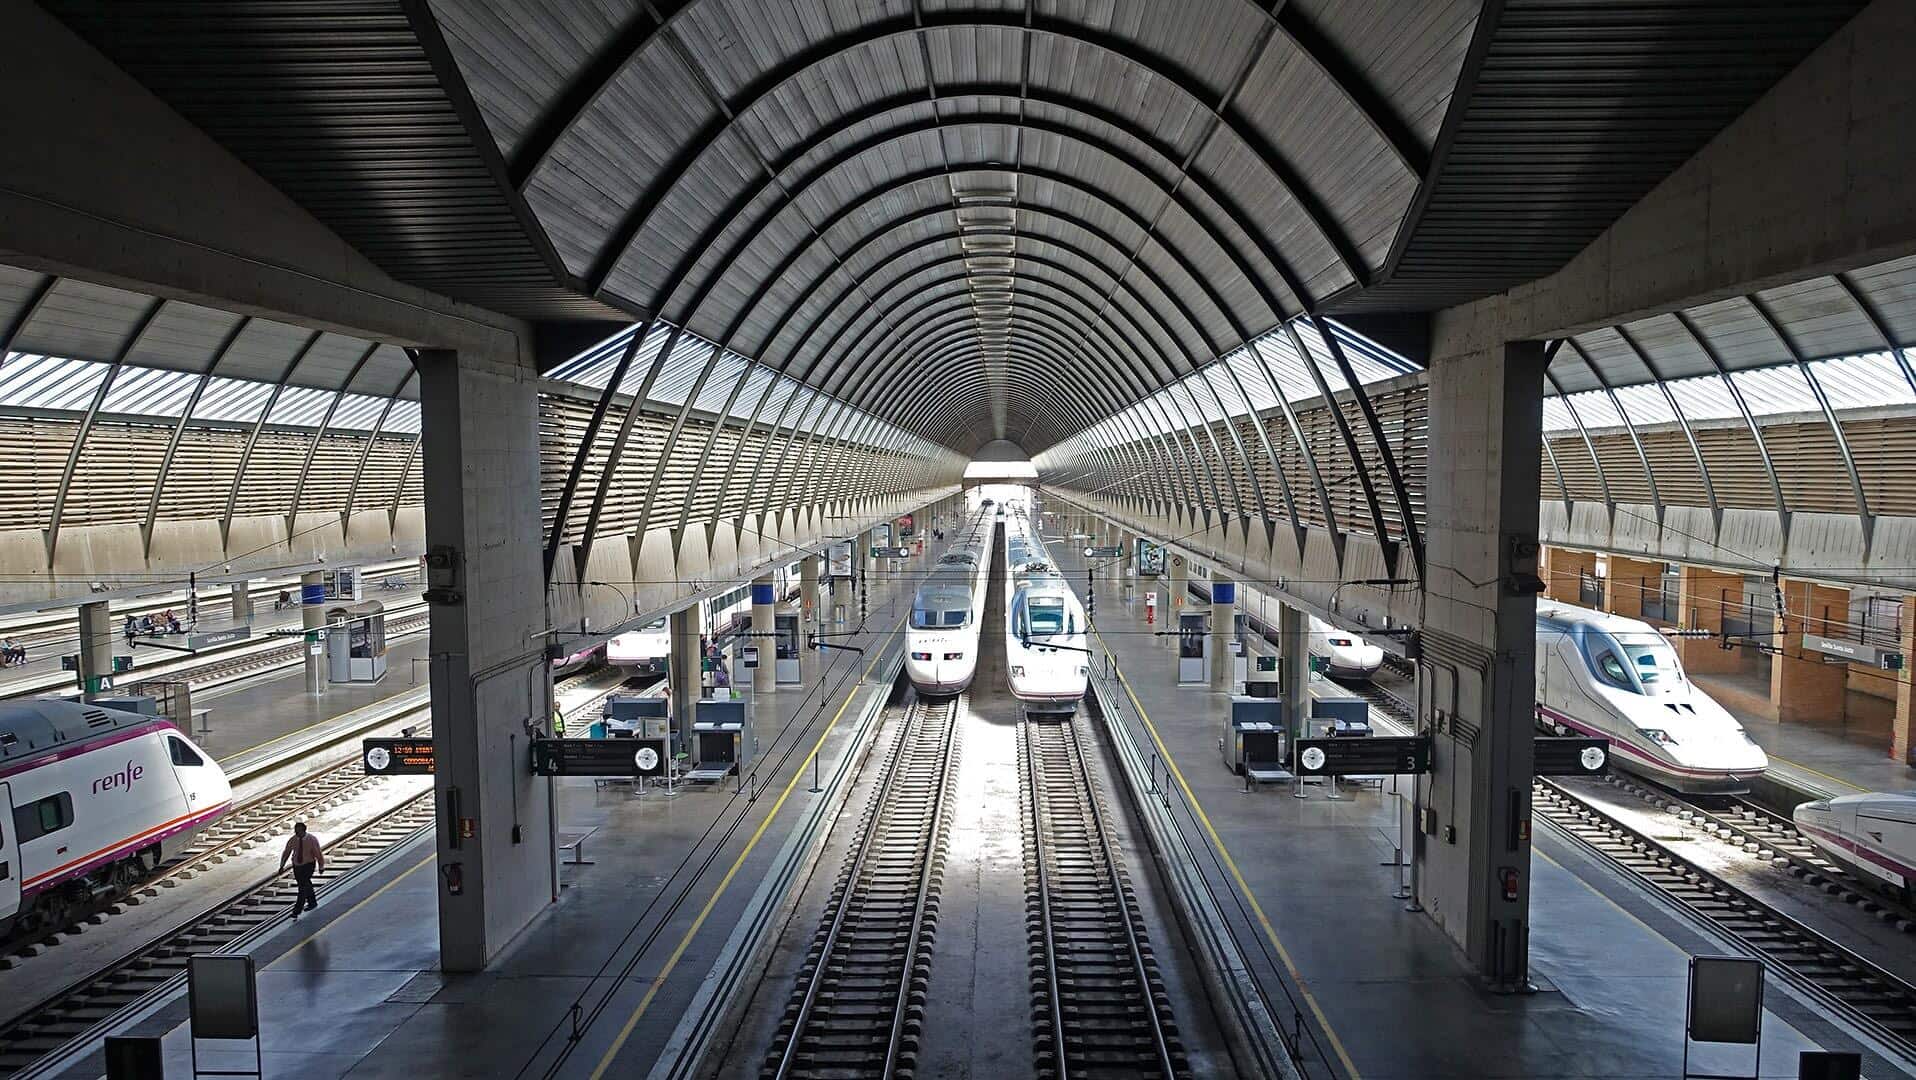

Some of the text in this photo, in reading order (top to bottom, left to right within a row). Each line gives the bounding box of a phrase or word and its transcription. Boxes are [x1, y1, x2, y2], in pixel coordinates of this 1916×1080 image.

[318, 630, 325, 640] B
[100, 677, 111, 690] A
[547, 758, 558, 773] 4
[1406, 757, 1415, 770] 3
[92, 760, 144, 795] renfe
